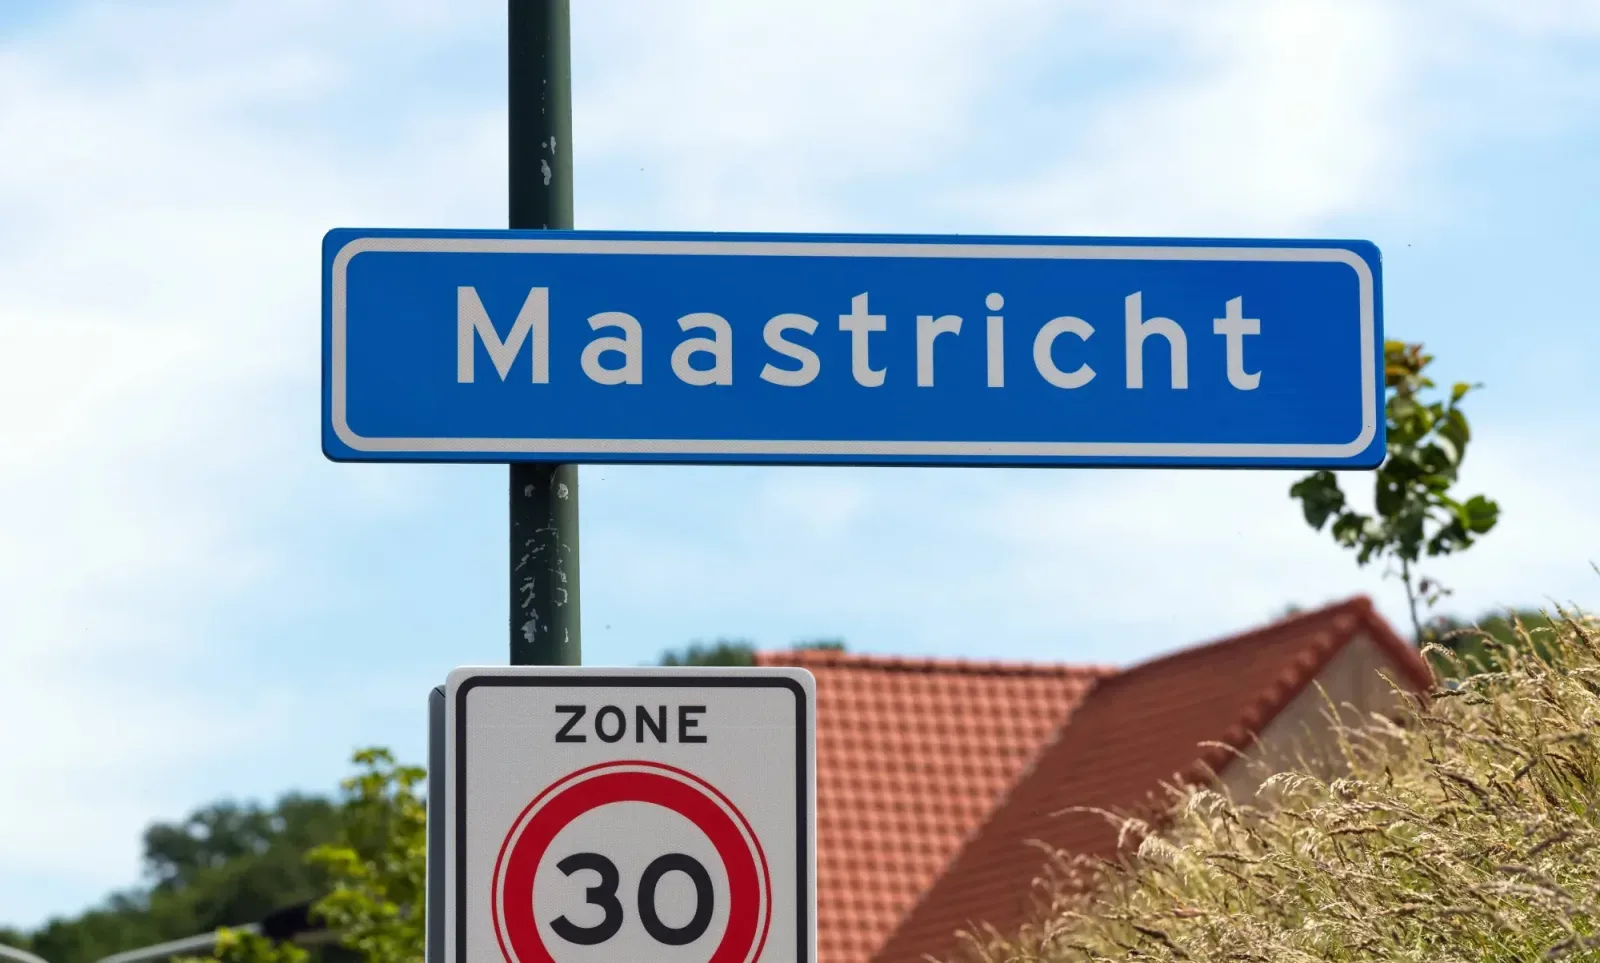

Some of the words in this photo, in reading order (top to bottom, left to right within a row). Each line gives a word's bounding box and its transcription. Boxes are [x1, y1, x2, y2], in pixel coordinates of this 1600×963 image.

[457, 286, 1262, 391] Maastricht
[554, 704, 708, 744] ZONE
[549, 852, 715, 946] 30
